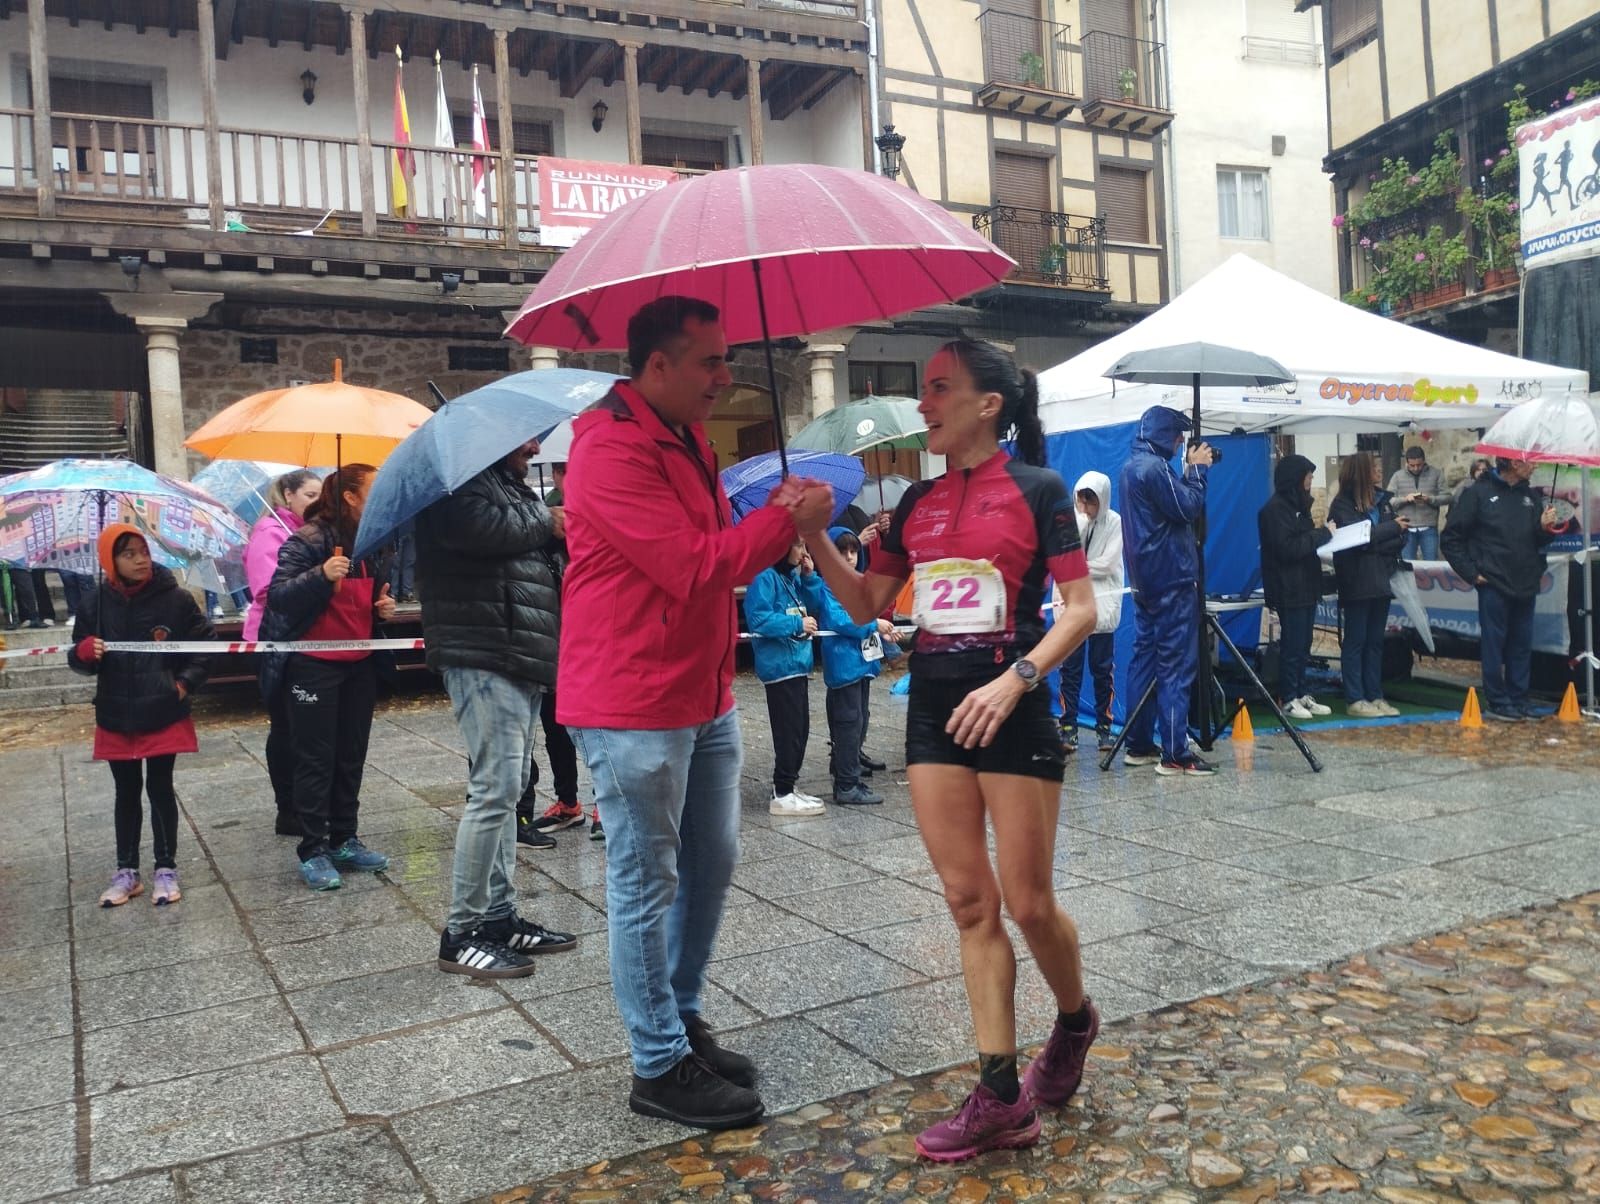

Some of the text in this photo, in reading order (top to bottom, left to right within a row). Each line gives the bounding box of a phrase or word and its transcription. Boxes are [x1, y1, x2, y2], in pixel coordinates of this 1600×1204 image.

[550, 169, 667, 190] RUNNING
[551, 181, 588, 211] LA
[931, 577, 981, 611] 22
[286, 640, 371, 650] Ayuntamiento de
